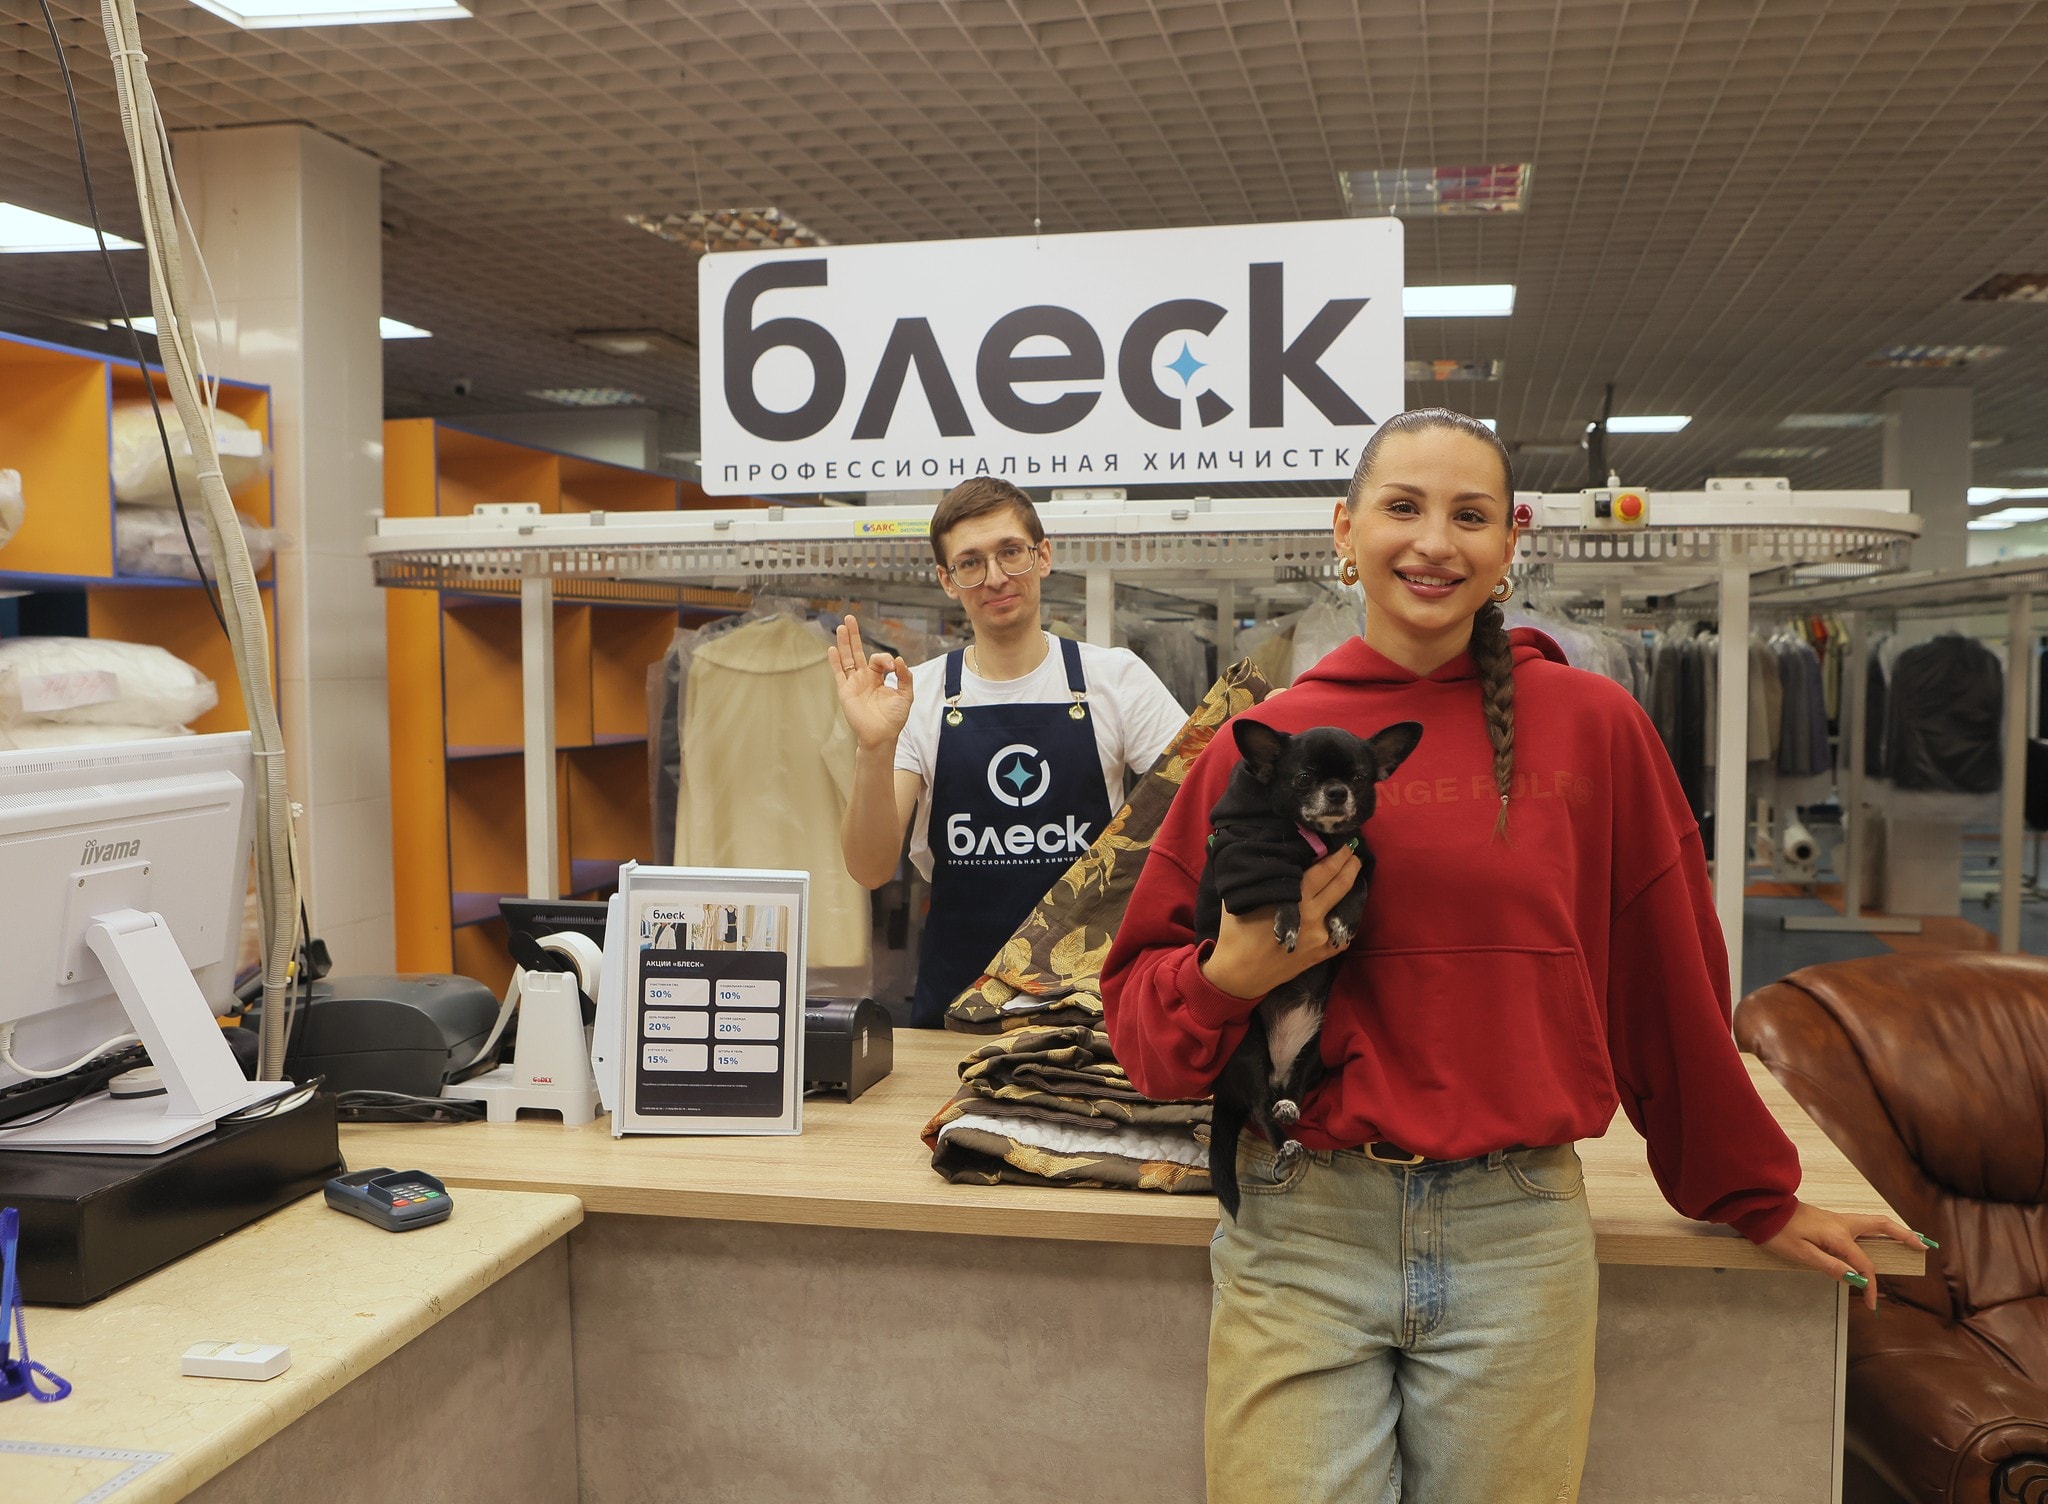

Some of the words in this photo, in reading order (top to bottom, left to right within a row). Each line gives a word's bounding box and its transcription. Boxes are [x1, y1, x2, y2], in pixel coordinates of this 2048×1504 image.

[723, 258, 1377, 442] блеск
[723, 453, 1119, 482] ПРОФЕССИОНАЛЬНАЯ
[1143, 448, 1350, 471] ХИМЧИСТК
[870, 523, 895, 532] SARC
[1375, 776, 1460, 807] NGE
[947, 813, 1092, 856] блеск
[81, 839, 140, 866] iiyama
[948, 858, 1041, 866] ПРОФЕССИОНАЛЬНАЯ
[653, 909, 685, 920] блеск
[646, 960, 672, 968] АКЦИИ
[649, 990, 672, 999] 30%
[719, 991, 741, 1000] 10%
[648, 1022, 671, 1031] 20%
[719, 1024, 742, 1033] 20%
[647, 1055, 668, 1064] 15%
[718, 1056, 739, 1065] 15%
